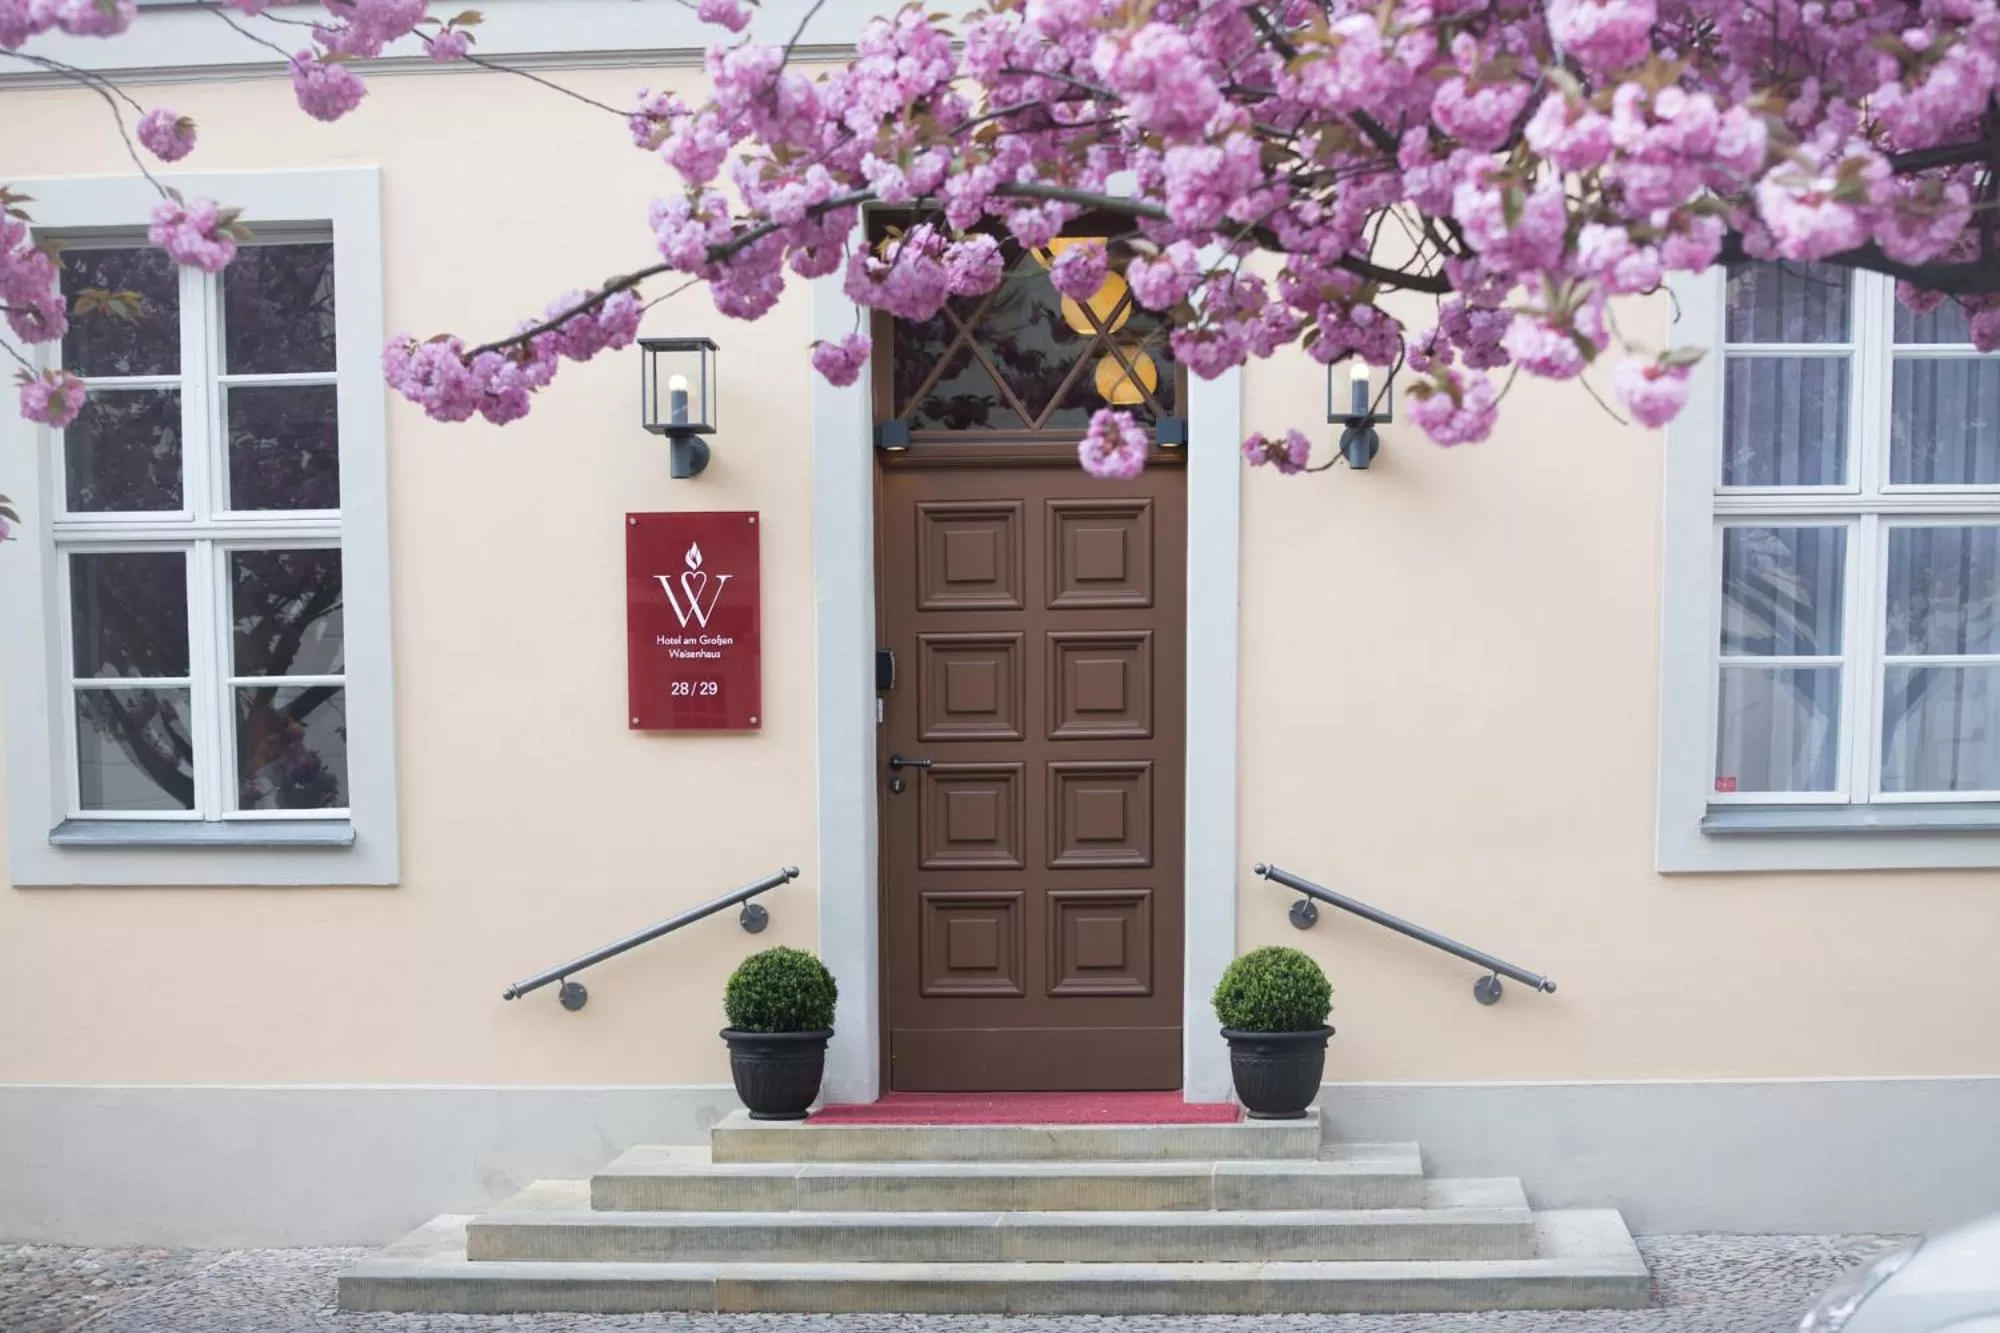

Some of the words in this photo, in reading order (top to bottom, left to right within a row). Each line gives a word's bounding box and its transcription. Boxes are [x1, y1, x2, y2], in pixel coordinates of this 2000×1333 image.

[653, 570, 734, 629] W
[656, 634, 682, 645] Hotel
[683, 637, 698, 645] am
[699, 634, 734, 646] Großen
[668, 648, 721, 659] Waisenhaus
